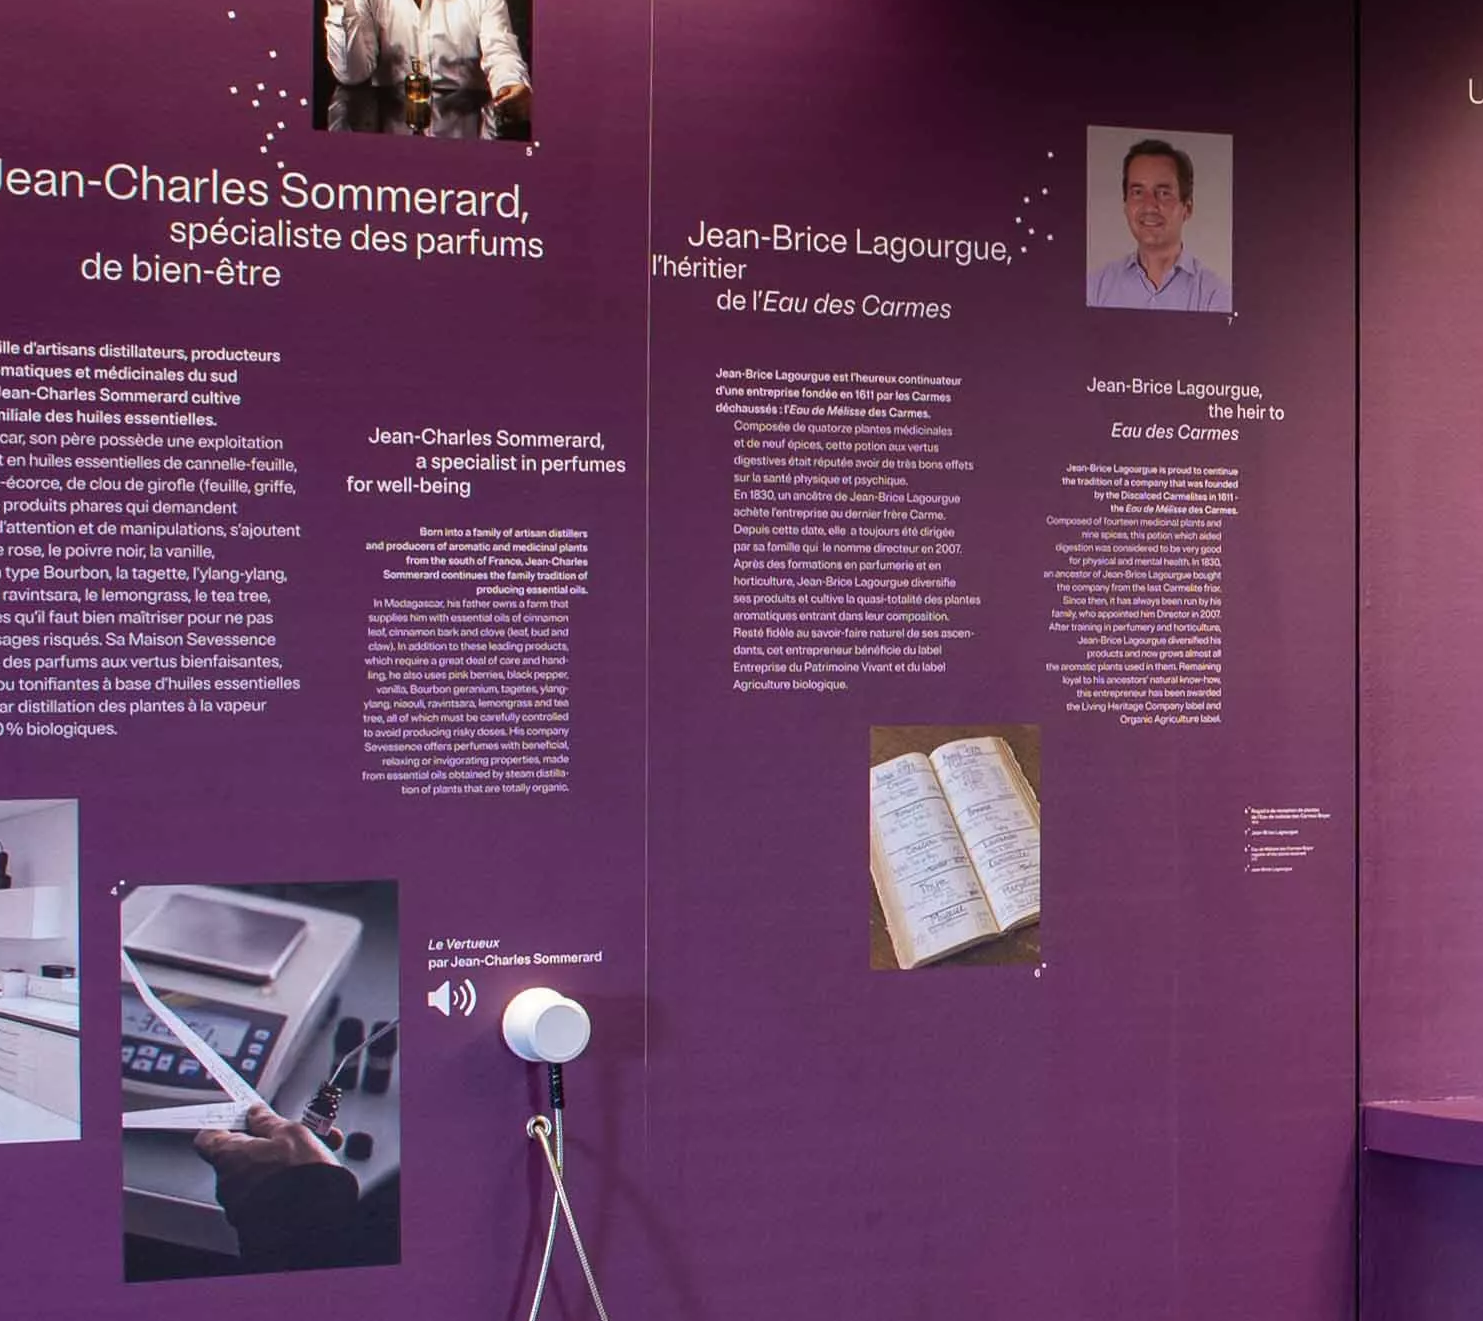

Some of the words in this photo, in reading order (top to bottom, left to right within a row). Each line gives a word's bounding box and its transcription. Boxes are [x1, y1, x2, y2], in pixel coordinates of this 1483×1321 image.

[525, 146, 533, 157] 5
[281, 172, 528, 224] Sommerard,
[170, 217, 342, 250] spécialiste
[351, 223, 407, 252] des
[417, 228, 543, 260] parfums
[688, 220, 847, 253] Jean-Brice
[856, 228, 1012, 266] Lagourgue,
[81, 252, 122, 281] de
[133, 253, 281, 287] bien-être
[651, 254, 747, 280] l'héritier
[717, 289, 746, 311] de
[753, 290, 808, 313] l'Eau
[814, 293, 856, 315] des
[862, 294, 952, 319] Carmes
[23, 341, 96, 357] d'artisans
[99, 344, 188, 361] distillateurs,
[191, 347, 281, 362] producteurs
[715, 368, 773, 380] Jean-Brice
[775, 369, 831, 384] Lagourgue
[832, 373, 849, 382] est
[850, 372, 897, 383] l'heureux
[898, 376, 962, 386] continuateur
[1086, 376, 1173, 394] Jean-Brice
[1177, 380, 1262, 401] Lagourgue,
[1208, 403, 1233, 418] the
[1237, 404, 1266, 420] heir
[1269, 406, 1285, 420] to
[368, 427, 492, 446] Jean-Charles
[496, 430, 605, 451] Sommerard,
[1111, 422, 1142, 438] Eau
[1145, 424, 1174, 439] des
[1178, 424, 1239, 441] Carmes
[416, 456, 427, 469] a
[431, 453, 517, 473] specialist
[521, 454, 537, 471] in
[541, 455, 626, 476] perfumes
[346, 475, 374, 492] for
[376, 476, 471, 498] well-being
[420, 527, 443, 536] Born
[445, 528, 464, 537] into
[465, 529, 472, 537] a
[472, 528, 501, 539] family
[502, 528, 513, 537] of
[514, 529, 547, 538] artisan
[548, 529, 588, 538] distillers
[1120, 714, 1153, 726] Organic
[1154, 715, 1199, 726] Agriculture
[1200, 714, 1222, 723] label.
[110, 886, 118, 896] 4
[428, 939, 444, 951] Le
[446, 938, 500, 950] Vertueux
[428, 959, 449, 970] par
[450, 954, 531, 968] Jean-Charles
[533, 951, 603, 965] Sommerard
